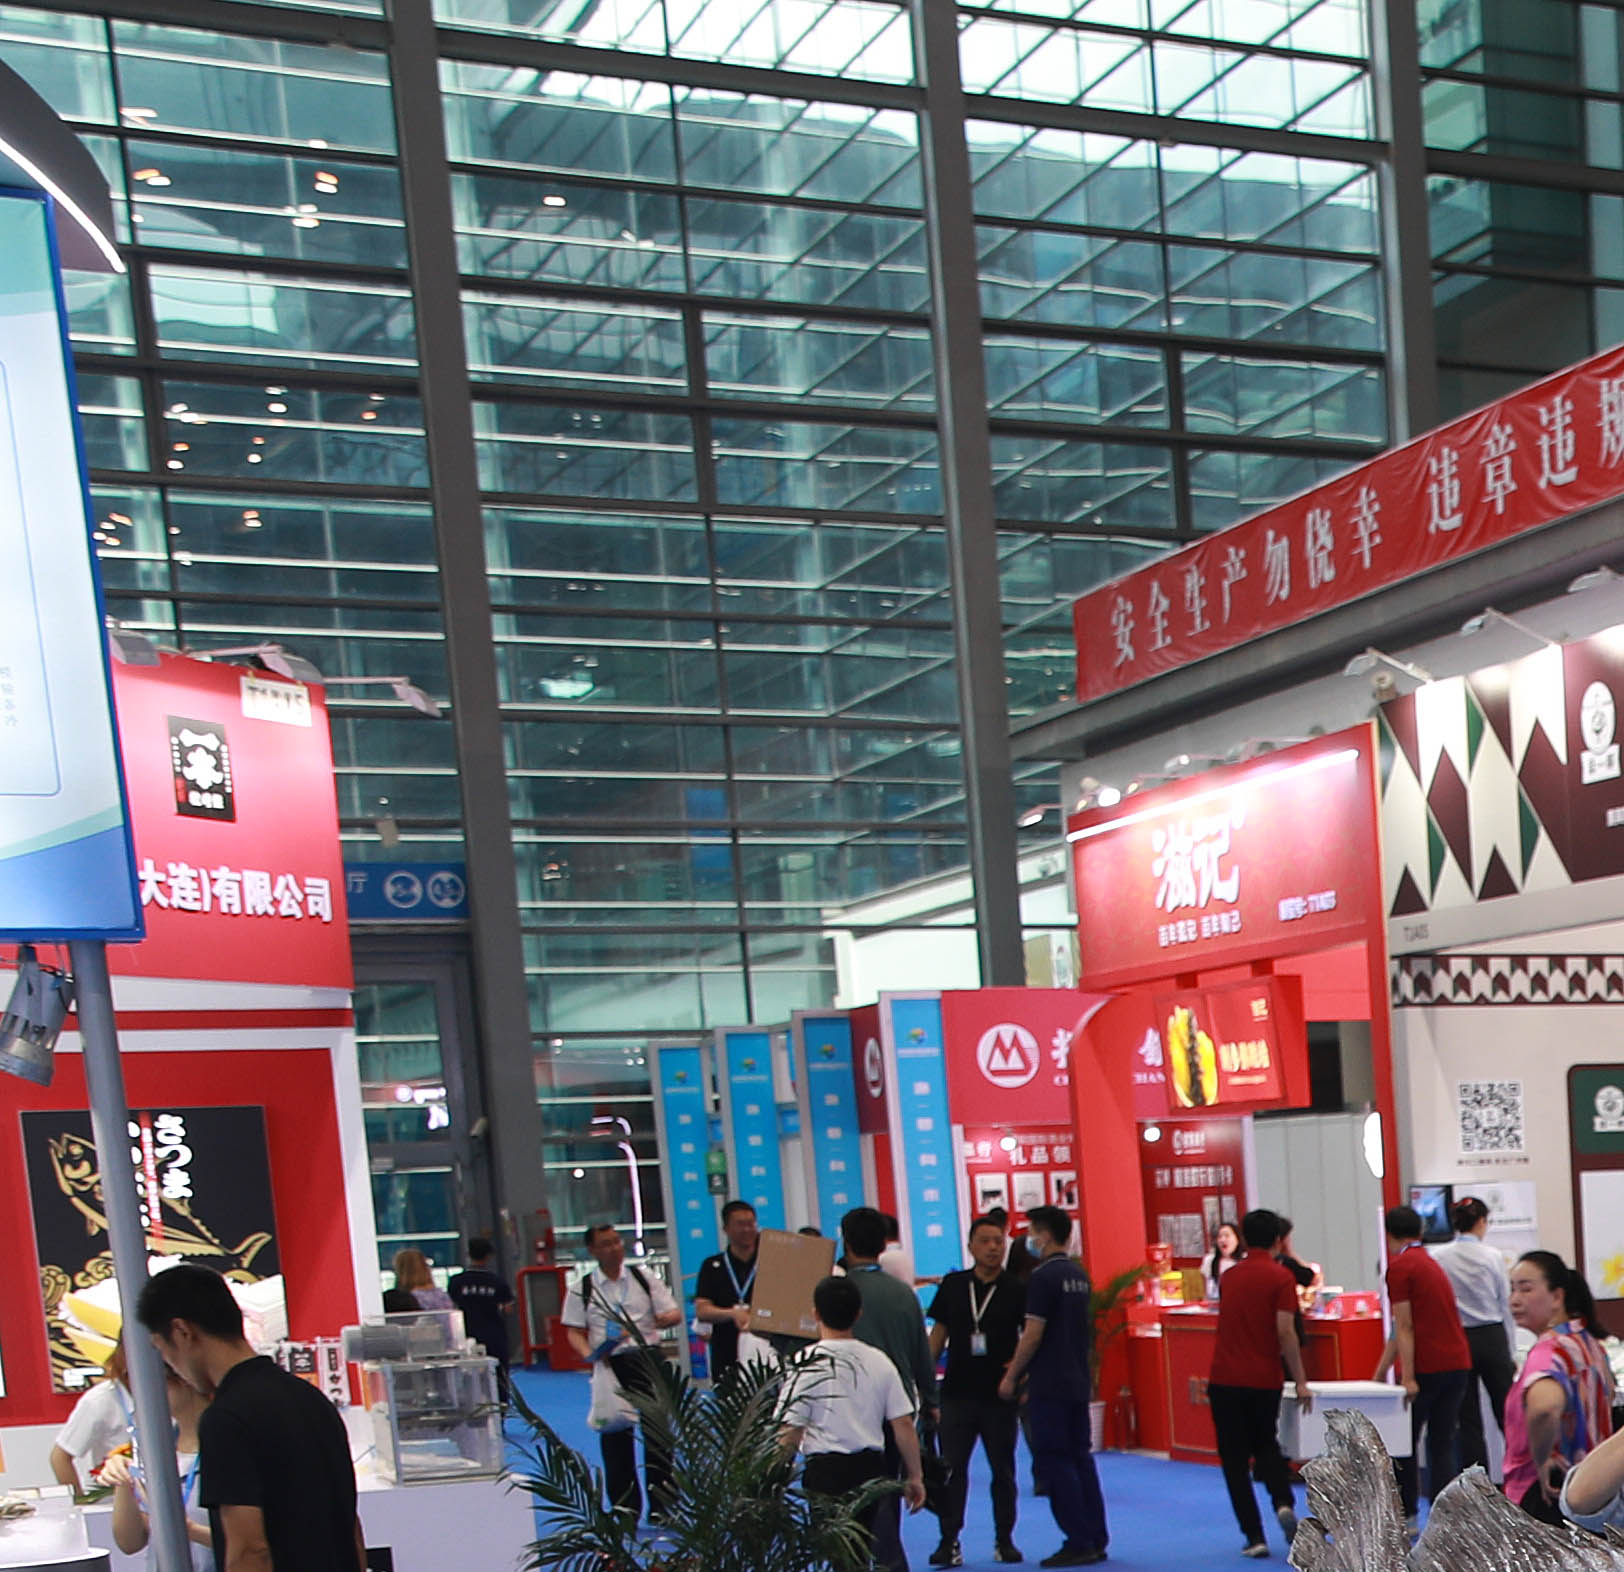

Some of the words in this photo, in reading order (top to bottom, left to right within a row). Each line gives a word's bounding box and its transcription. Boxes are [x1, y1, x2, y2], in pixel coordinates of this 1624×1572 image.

[1111, 487, 1384, 669] 安全生产勿侥幸
